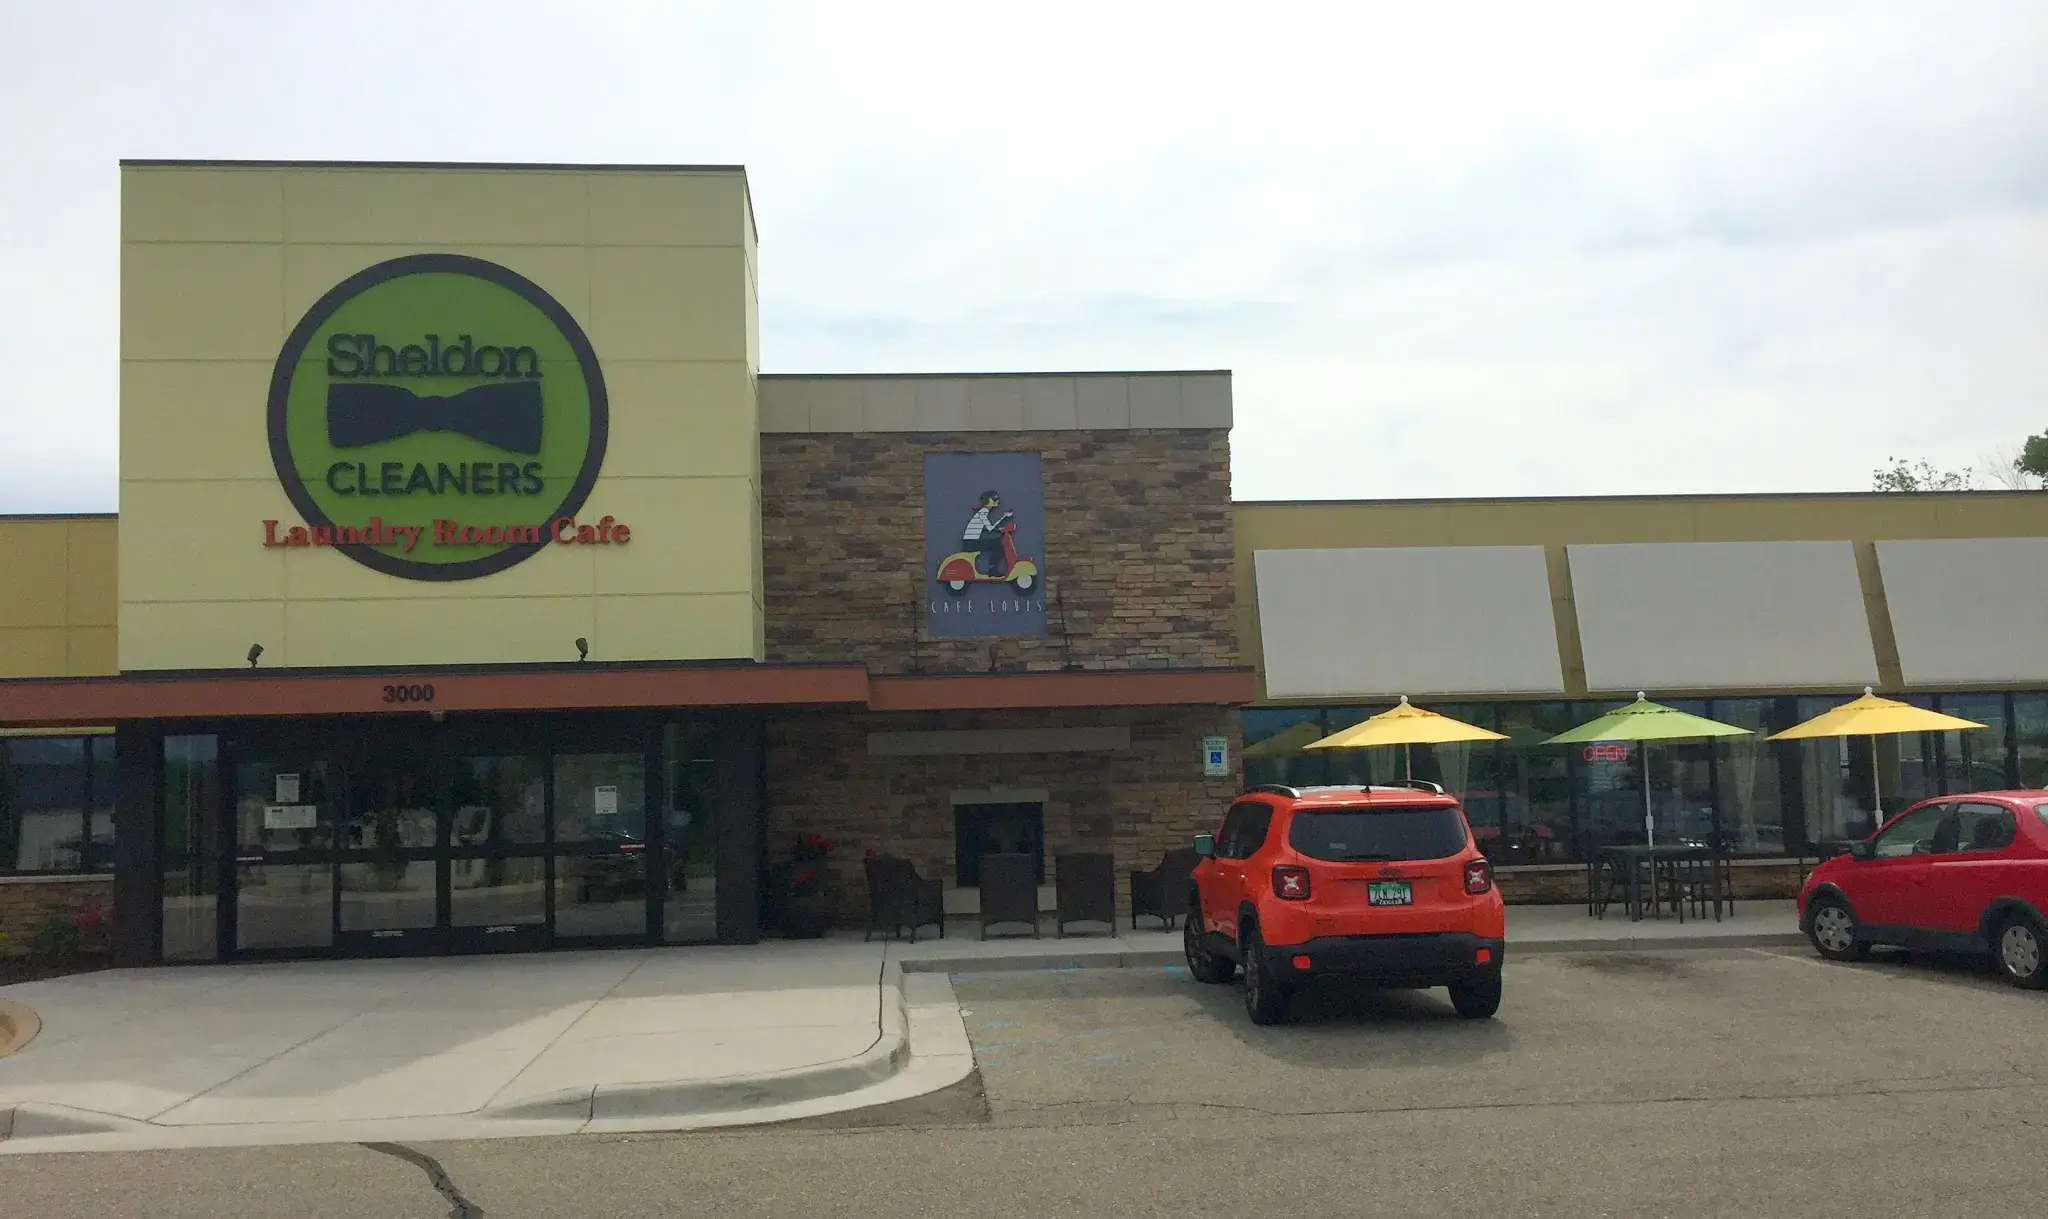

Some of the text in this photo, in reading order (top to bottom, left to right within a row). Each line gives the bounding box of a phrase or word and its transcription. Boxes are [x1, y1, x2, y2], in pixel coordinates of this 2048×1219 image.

[327, 333, 543, 378] Sheldon
[326, 461, 543, 495] CLEANERS
[262, 515, 631, 553] Laundry Room Cafe
[382, 684, 435, 703] 3000
[1583, 744, 1627, 763] OPEN
